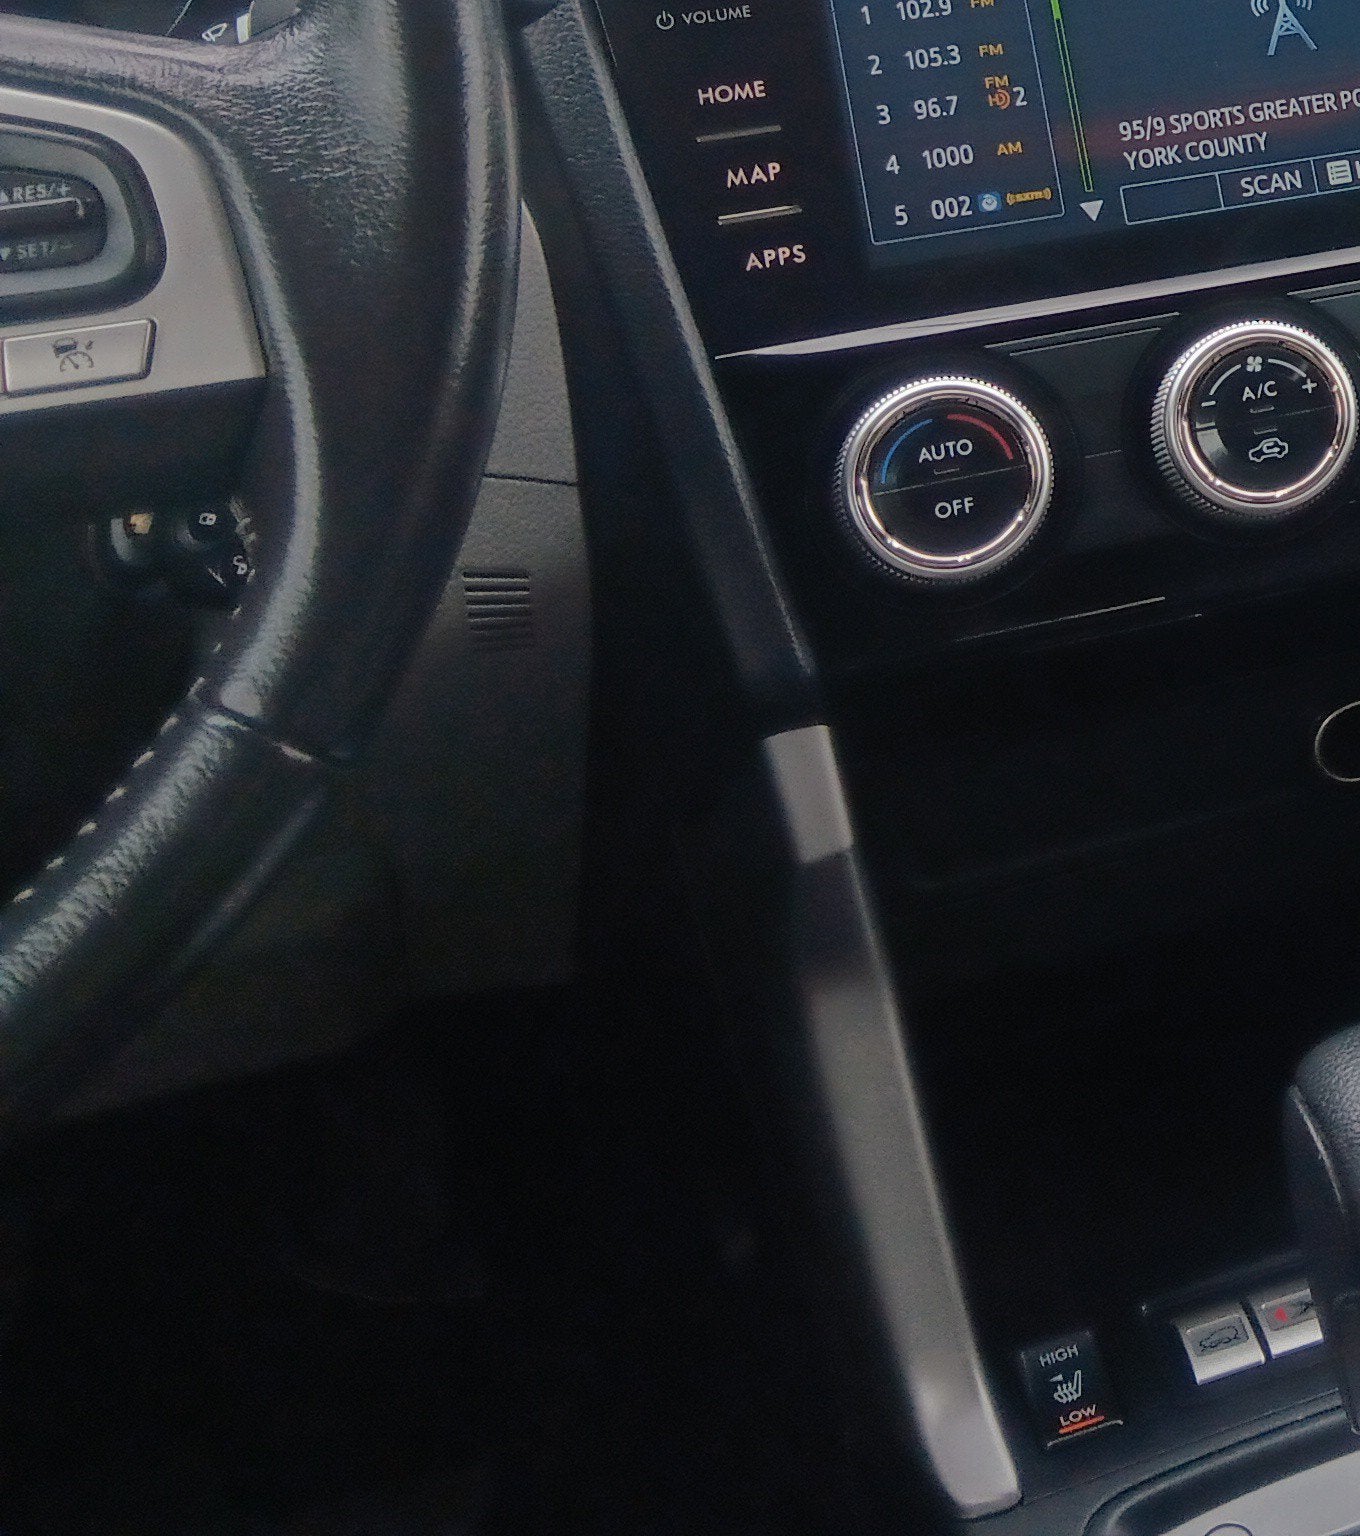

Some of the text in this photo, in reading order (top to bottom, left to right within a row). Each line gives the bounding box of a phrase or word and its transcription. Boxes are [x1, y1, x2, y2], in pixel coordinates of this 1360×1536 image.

[681, 4, 752, 26] VOLUME
[860, 5, 872, 26] 1
[867, 43, 1004, 76] 2 105.3 FM
[698, 79, 768, 106] HOME
[984, 74, 1009, 90] FM
[875, 104, 892, 125] 3
[913, 95, 958, 121] 96.7
[1012, 87, 1028, 108] 2
[1118, 116, 1166, 142] 95/9
[1170, 105, 1246, 135] SPORTS
[1249, 95, 1338, 124] GREATER
[885, 141, 1023, 175] 4 1000 AM
[1123, 131, 1268, 172] YORK COUNTY
[726, 161, 782, 189] MAP
[1240, 168, 1303, 199] SCAN
[894, 195, 973, 226] 5 002
[745, 244, 808, 272] APPS
[1242, 380, 1278, 402] A/C
[918, 438, 973, 463] AUTO
[934, 496, 975, 519] OFF
[1039, 1344, 1079, 1367] HIGH
[1059, 1404, 1097, 1426] LOW
